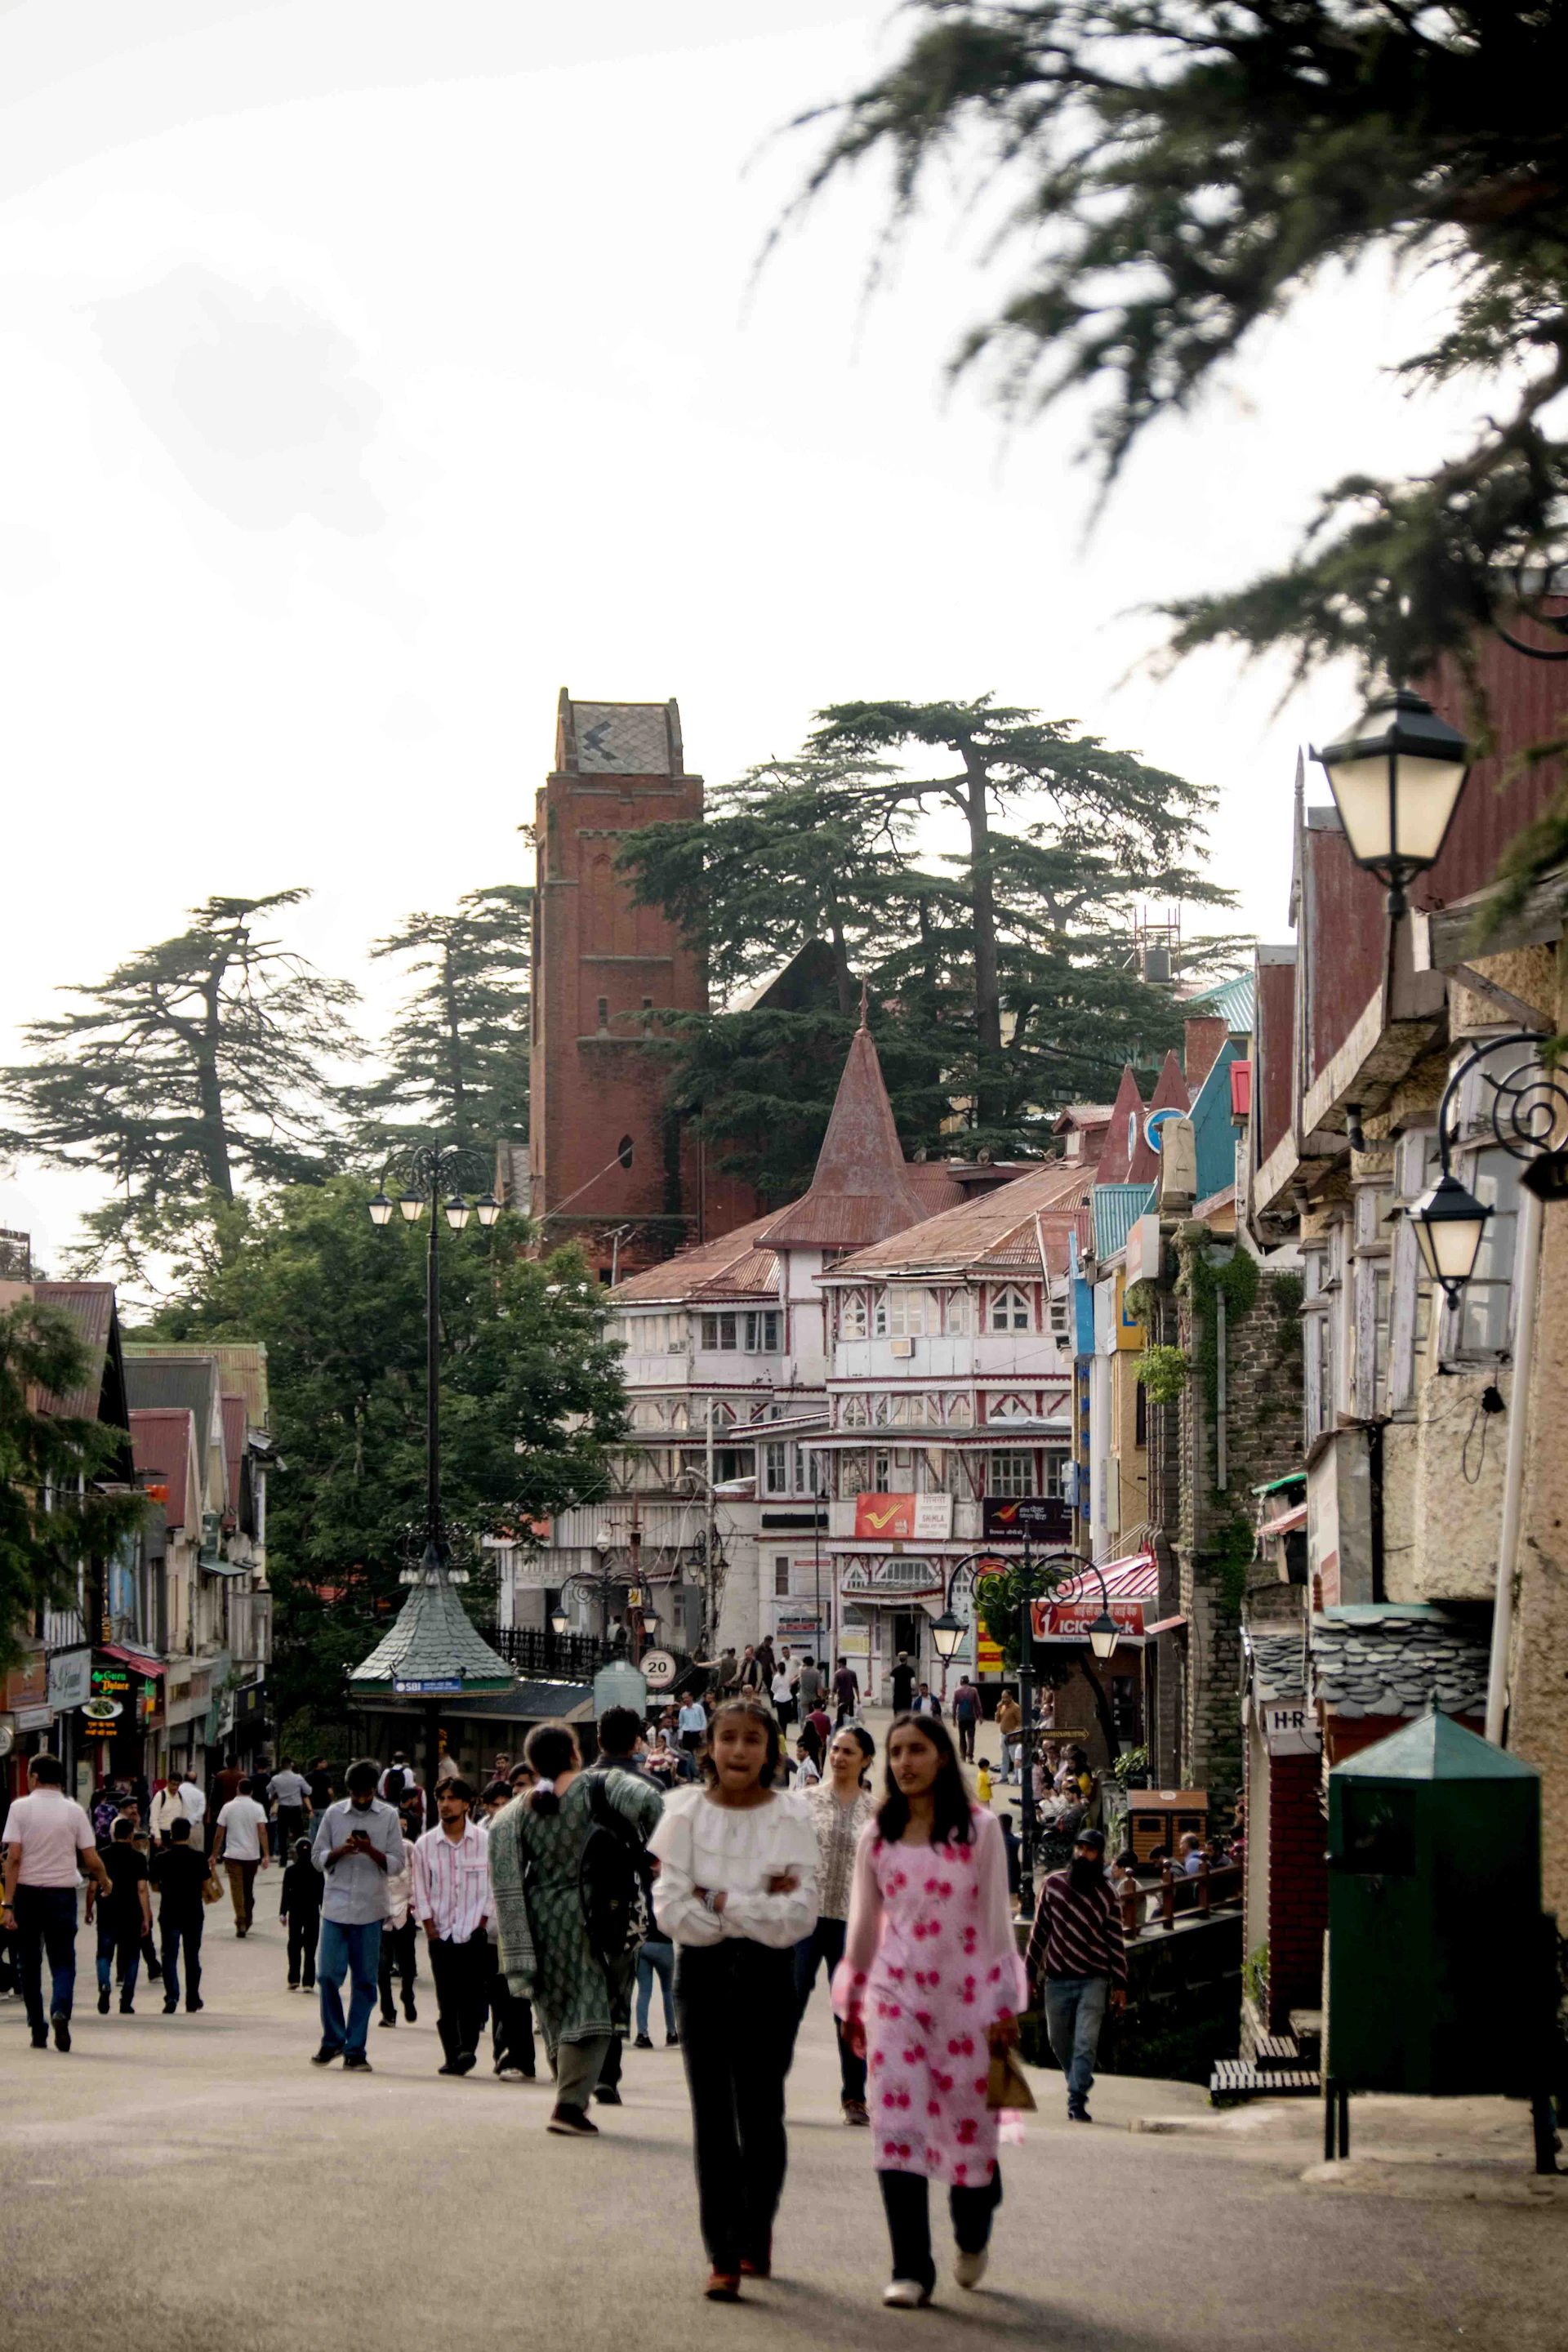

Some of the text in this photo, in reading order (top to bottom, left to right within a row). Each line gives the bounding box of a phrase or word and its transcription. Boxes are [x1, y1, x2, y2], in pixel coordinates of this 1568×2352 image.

[922, 1514, 944, 1522] SHIMLA
[1059, 1619, 1093, 1633] ICIC
[648, 1662, 667, 1673] 20
[405, 1682, 421, 1691] SBI
